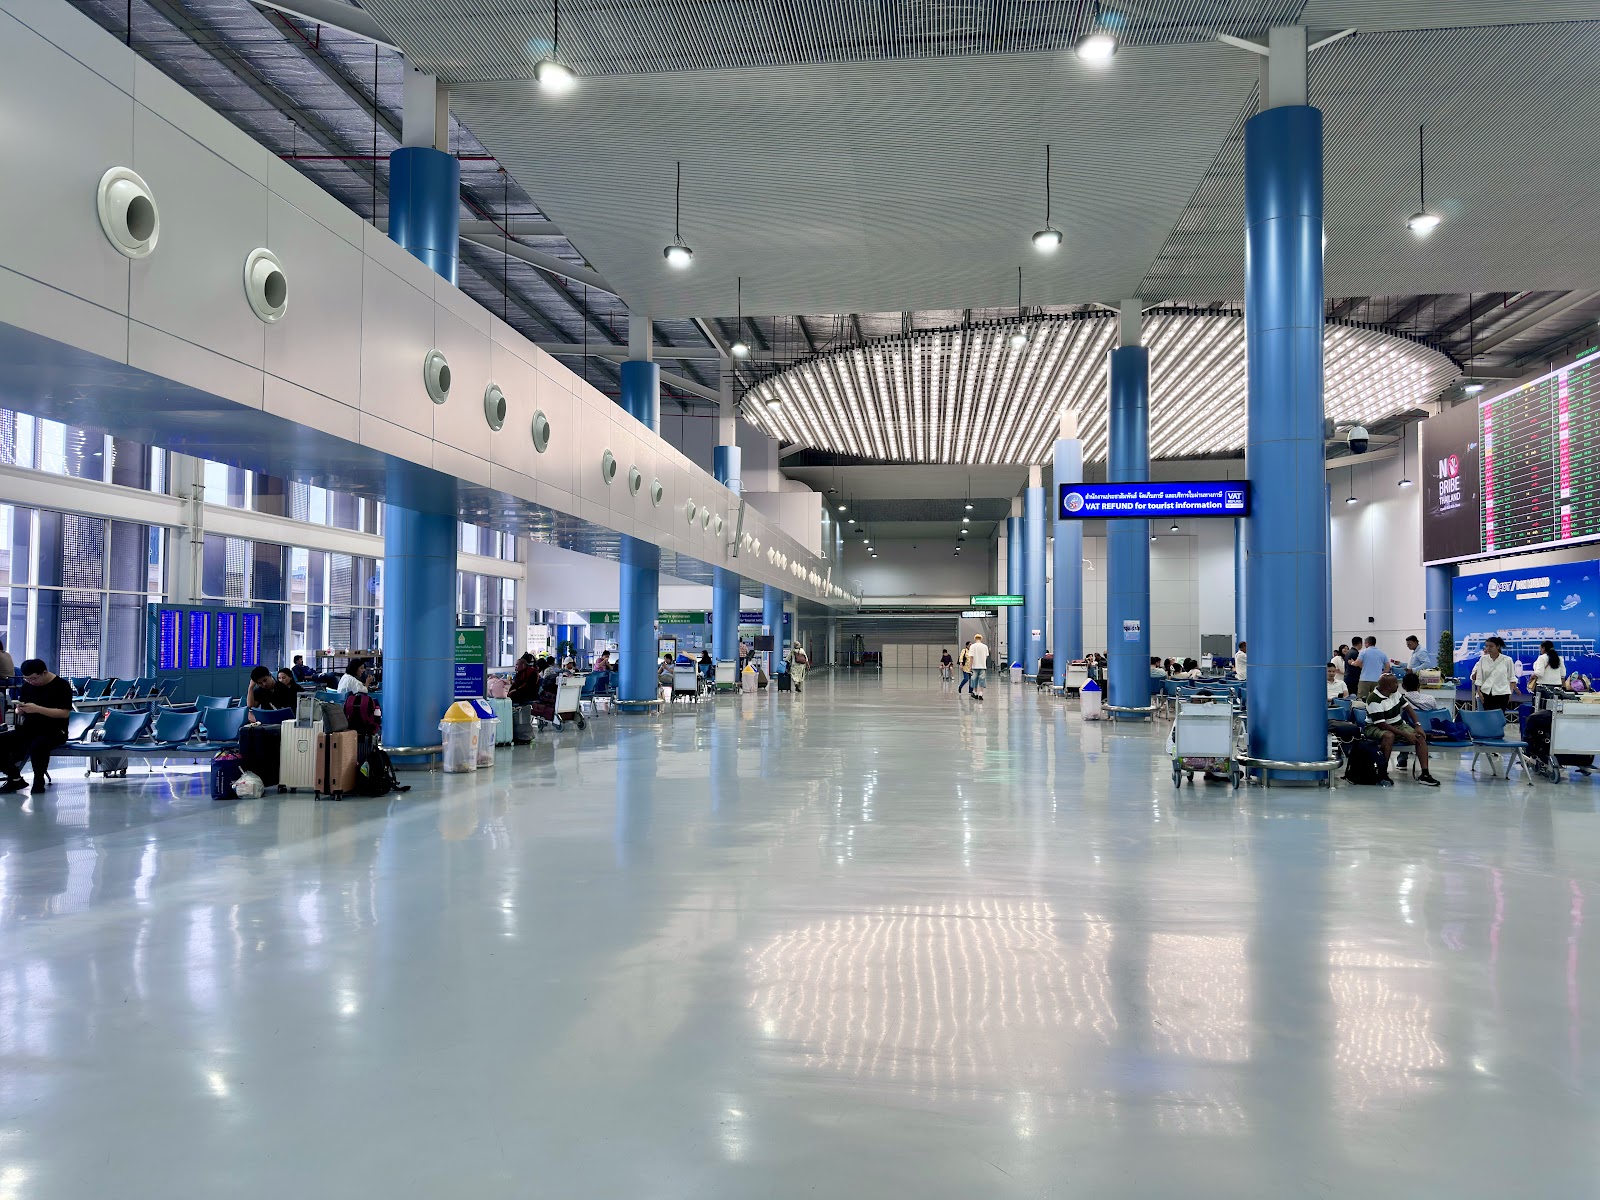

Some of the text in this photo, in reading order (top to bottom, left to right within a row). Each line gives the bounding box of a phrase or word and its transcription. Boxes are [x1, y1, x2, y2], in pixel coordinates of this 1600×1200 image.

[1439, 476, 1460, 496] BRIBE
[1439, 492, 1461, 505] THAILAND
[1101, 502, 1134, 510] REFUND
[1175, 501, 1222, 509] information
